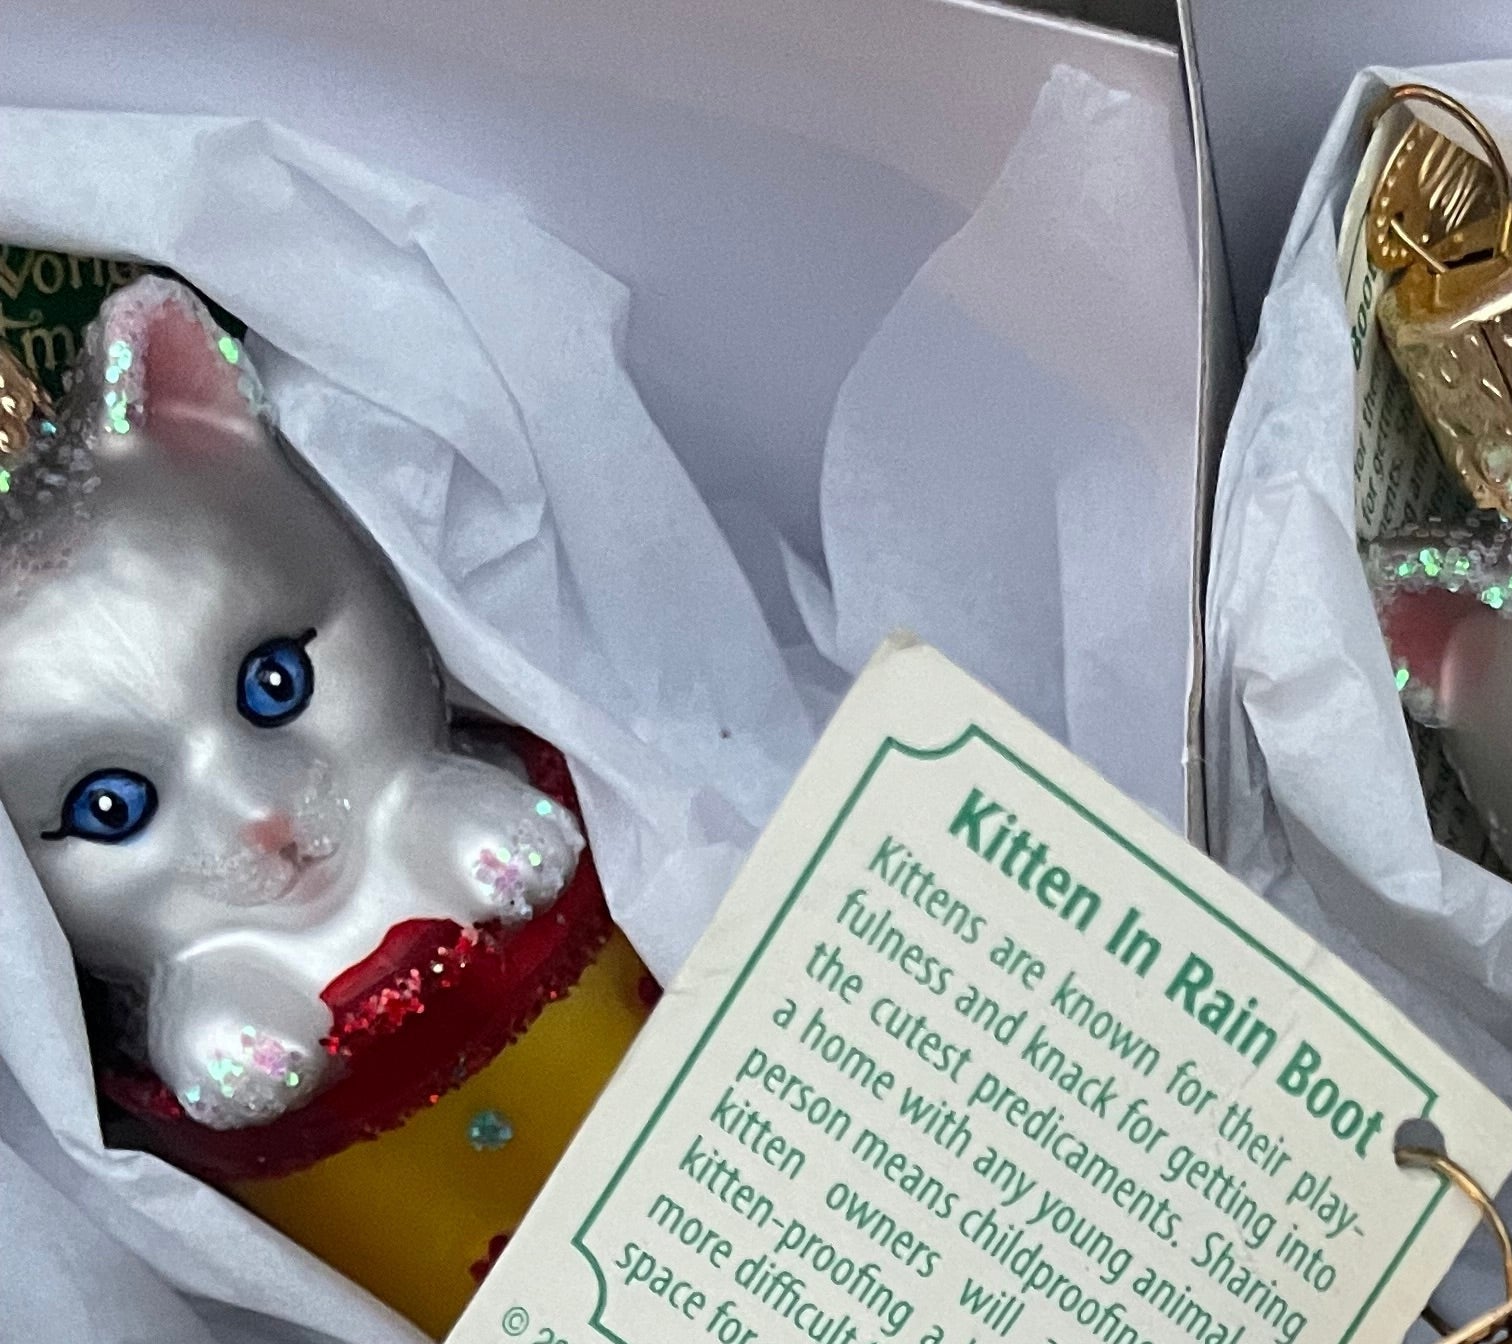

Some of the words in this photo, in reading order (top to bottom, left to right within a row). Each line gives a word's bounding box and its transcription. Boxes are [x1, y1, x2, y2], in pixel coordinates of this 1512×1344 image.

[805, 941, 864, 1005] the
[869, 997, 972, 1084] cutest
[966, 1071, 1183, 1248] predicaments.
[836, 888, 955, 996] fulness
[954, 984, 1029, 1046] and
[1020, 1024, 1119, 1120] knack
[1116, 1098, 1170, 1154] for
[1159, 1145, 1278, 1250] getting
[1275, 1223, 1337, 1293] into
[867, 835, 987, 945] Kittens
[989, 935, 1046, 991] are
[1050, 970, 1161, 1077] known
[1165, 1059, 1219, 1115] for
[1217, 1101, 1293, 1178] their
[1285, 1170, 1364, 1239] play-
[947, 786, 1103, 934] Kitten
[1104, 906, 1162, 979] In
[1163, 951, 1278, 1069] Rain
[1275, 1039, 1385, 1161] Boot
[647, 1193, 733, 1269] more
[678, 1134, 915, 1338] kitten-proofing
[709, 1085, 806, 1181] kitten
[825, 1182, 942, 1278] owners
[959, 1277, 1026, 1338] will
[735, 1047, 852, 1142] person
[851, 1128, 960, 1219] means
[772, 998, 798, 1030] a
[799, 1007, 896, 1101] home
[899, 1086, 973, 1159] with
[972, 1146, 1038, 1208] any
[1025, 1190, 1134, 1286] young
[501, 1306, 530, 1337] ©
[614, 1241, 707, 1321] space
